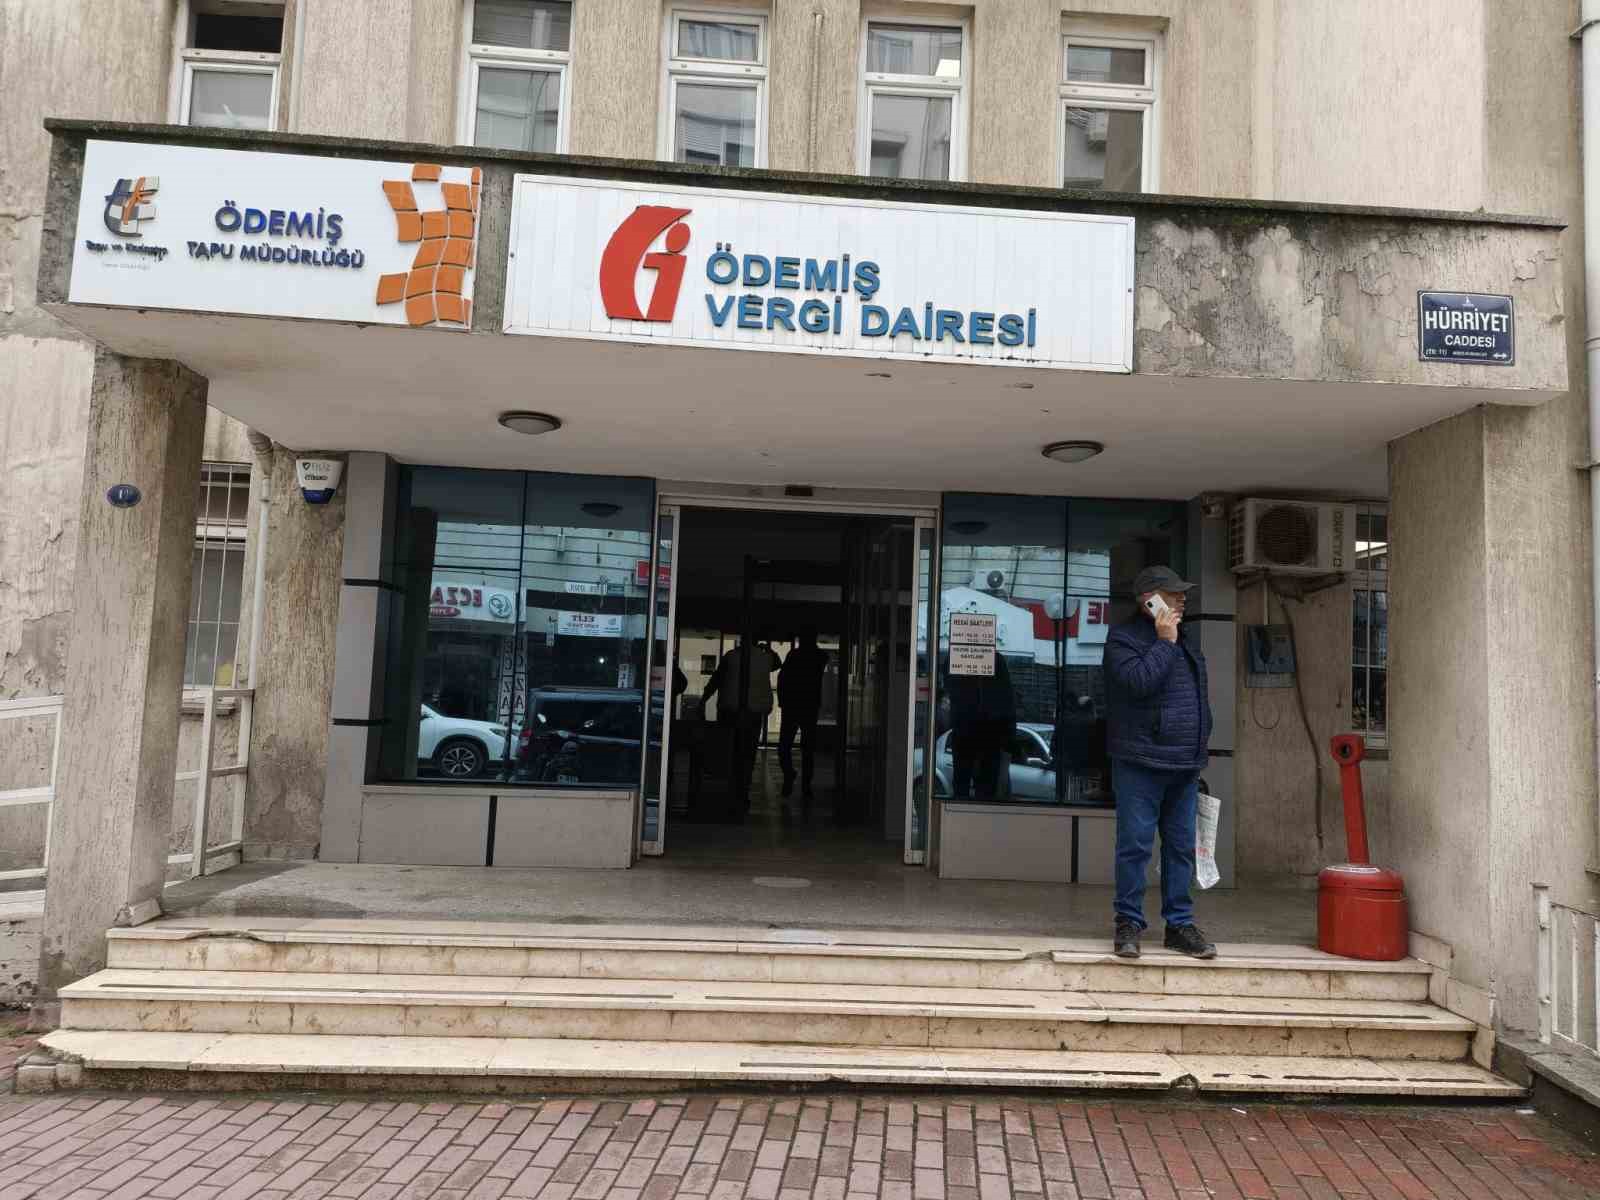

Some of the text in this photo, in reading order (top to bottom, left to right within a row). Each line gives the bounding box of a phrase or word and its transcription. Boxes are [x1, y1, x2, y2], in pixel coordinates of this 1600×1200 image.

[215, 199, 344, 246] ÖDEMİŞ
[187, 241, 366, 269] TAPU MÜDÜRLÜĞÜ
[706, 242, 881, 301] ÖDEMİŞ
[705, 294, 1037, 348] VERGİ DAİRESİ
[1425, 306, 1509, 333] HÜRRİYET
